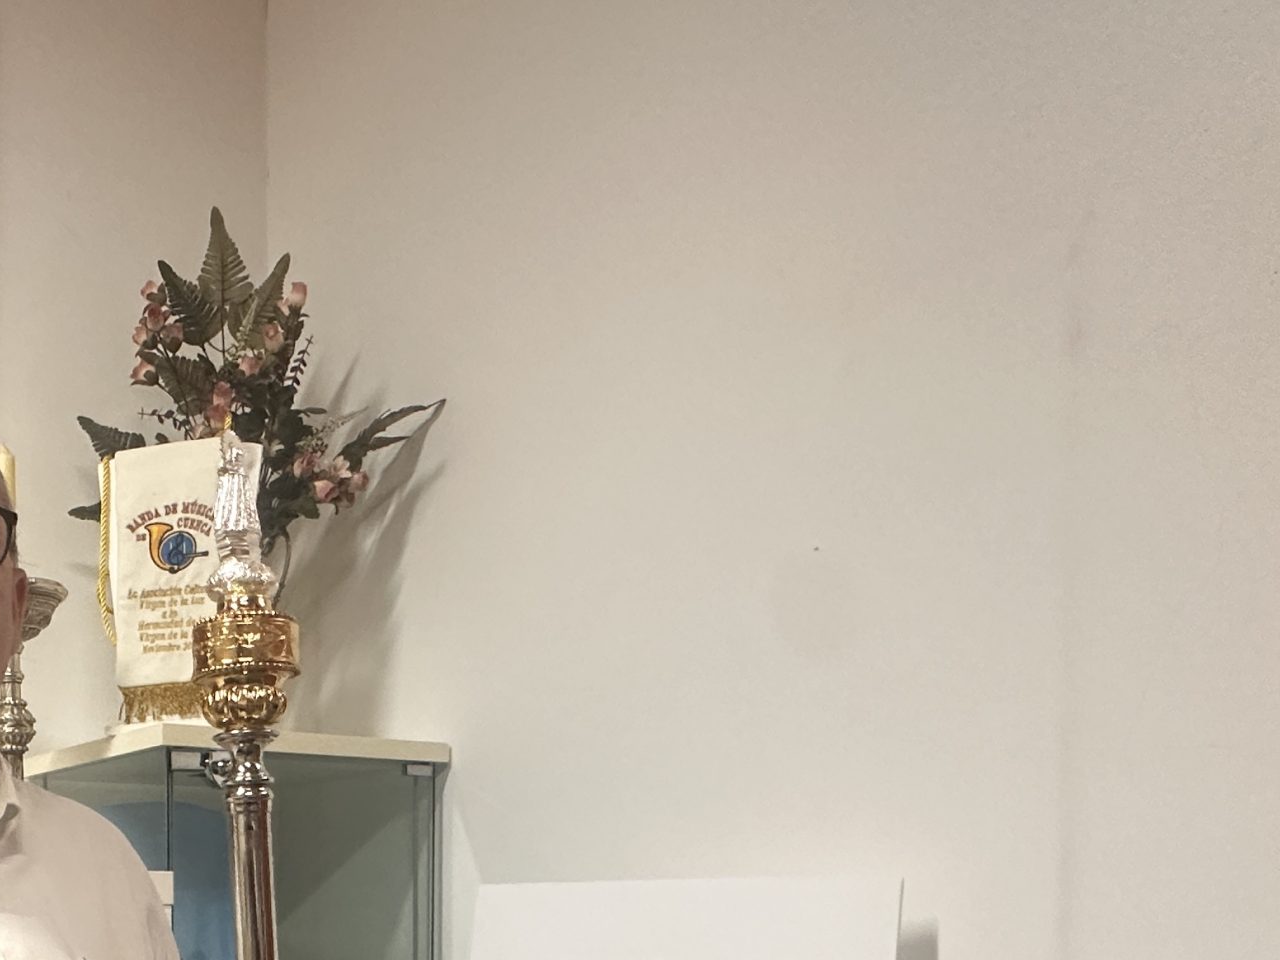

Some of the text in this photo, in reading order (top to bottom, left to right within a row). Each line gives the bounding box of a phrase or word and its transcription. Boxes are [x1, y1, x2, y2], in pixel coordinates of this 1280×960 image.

[126, 508, 161, 533] BANDA
[164, 503, 178, 516] DE
[136, 517, 212, 541] DE CUENCA
[168, 598, 177, 607] de
[180, 597, 188, 605] la
[167, 630, 178, 640] de
[180, 629, 188, 639] la
